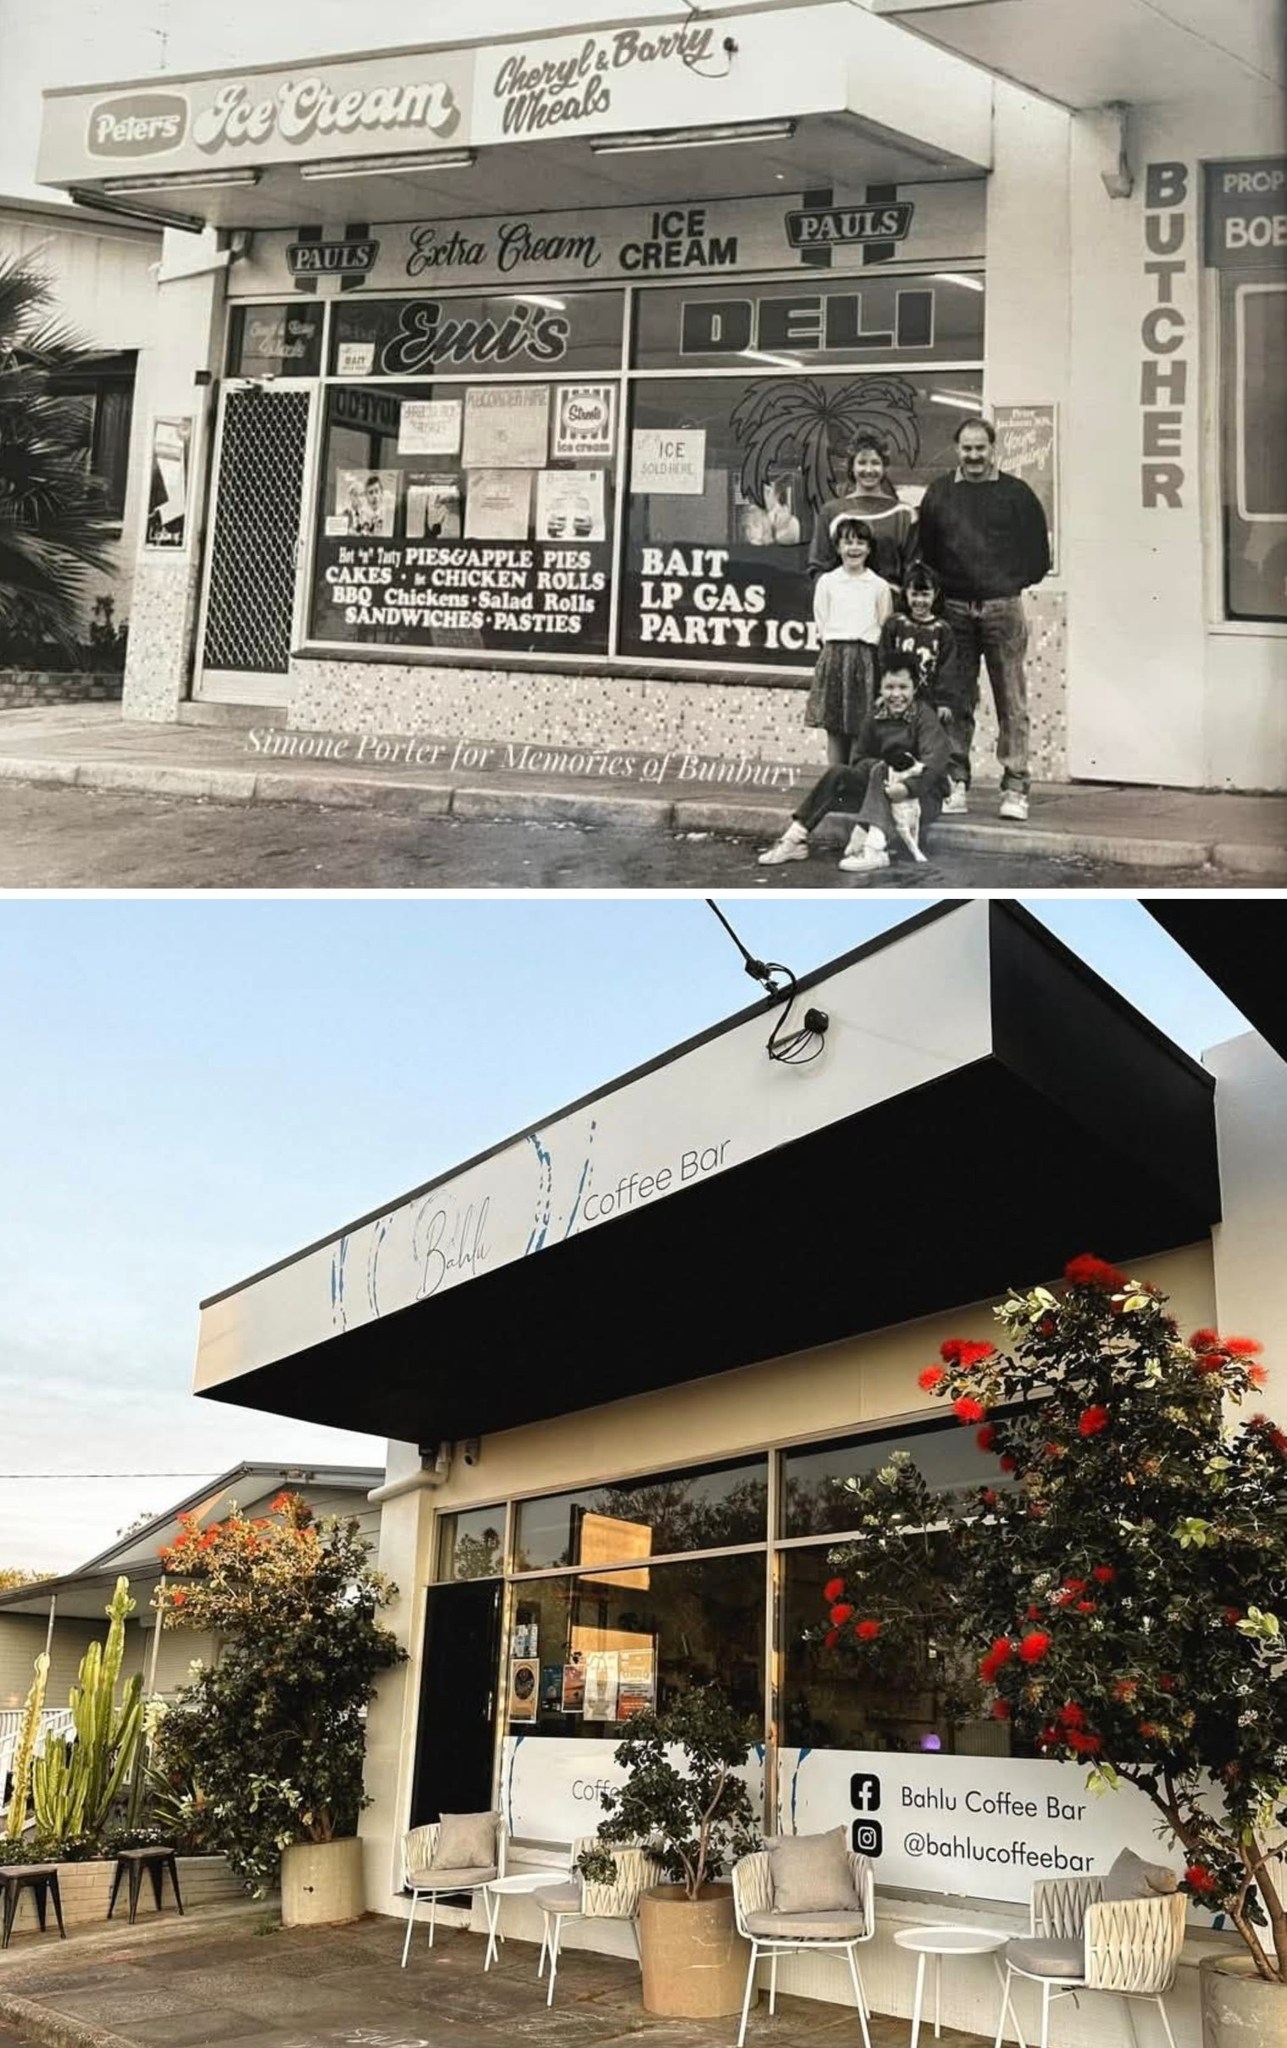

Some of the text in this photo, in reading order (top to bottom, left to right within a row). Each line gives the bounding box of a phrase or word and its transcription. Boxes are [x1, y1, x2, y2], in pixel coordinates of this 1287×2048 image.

[493, 28, 714, 95] Cheryl & Barry
[193, 77, 460, 153] Ice Cream
[502, 74, 611, 134] Wheals
[96, 113, 181, 144] Peters
[1223, 170, 1285, 193] PROP
[651, 209, 706, 240] ICE
[799, 209, 899, 241] PAULS
[295, 245, 370, 271] PAULS
[406, 222, 602, 276] Extra Cream
[618, 237, 738, 271] CREAM
[381, 300, 571, 374] Emi's
[679, 288, 935, 356] DELI
[1139, 161, 1188, 508] BUTCHER
[660, 441, 686, 459] ICE
[543, 550, 591, 569] PIES
[641, 547, 729, 577] BAIT
[325, 566, 393, 585] CAKES
[431, 568, 527, 589] CHICKEN
[537, 571, 605, 591] ROLLS
[332, 585, 595, 613] BBQ Chickens Salad Rolls
[641, 583, 766, 613] LP GAS
[640, 613, 752, 645] PARTY
[584, 1139, 731, 1221] Coffee Bar
[901, 1786, 1087, 1822] Bahlu Coffee Bar
[903, 1831, 1095, 1874] @bahlucoffeebar
